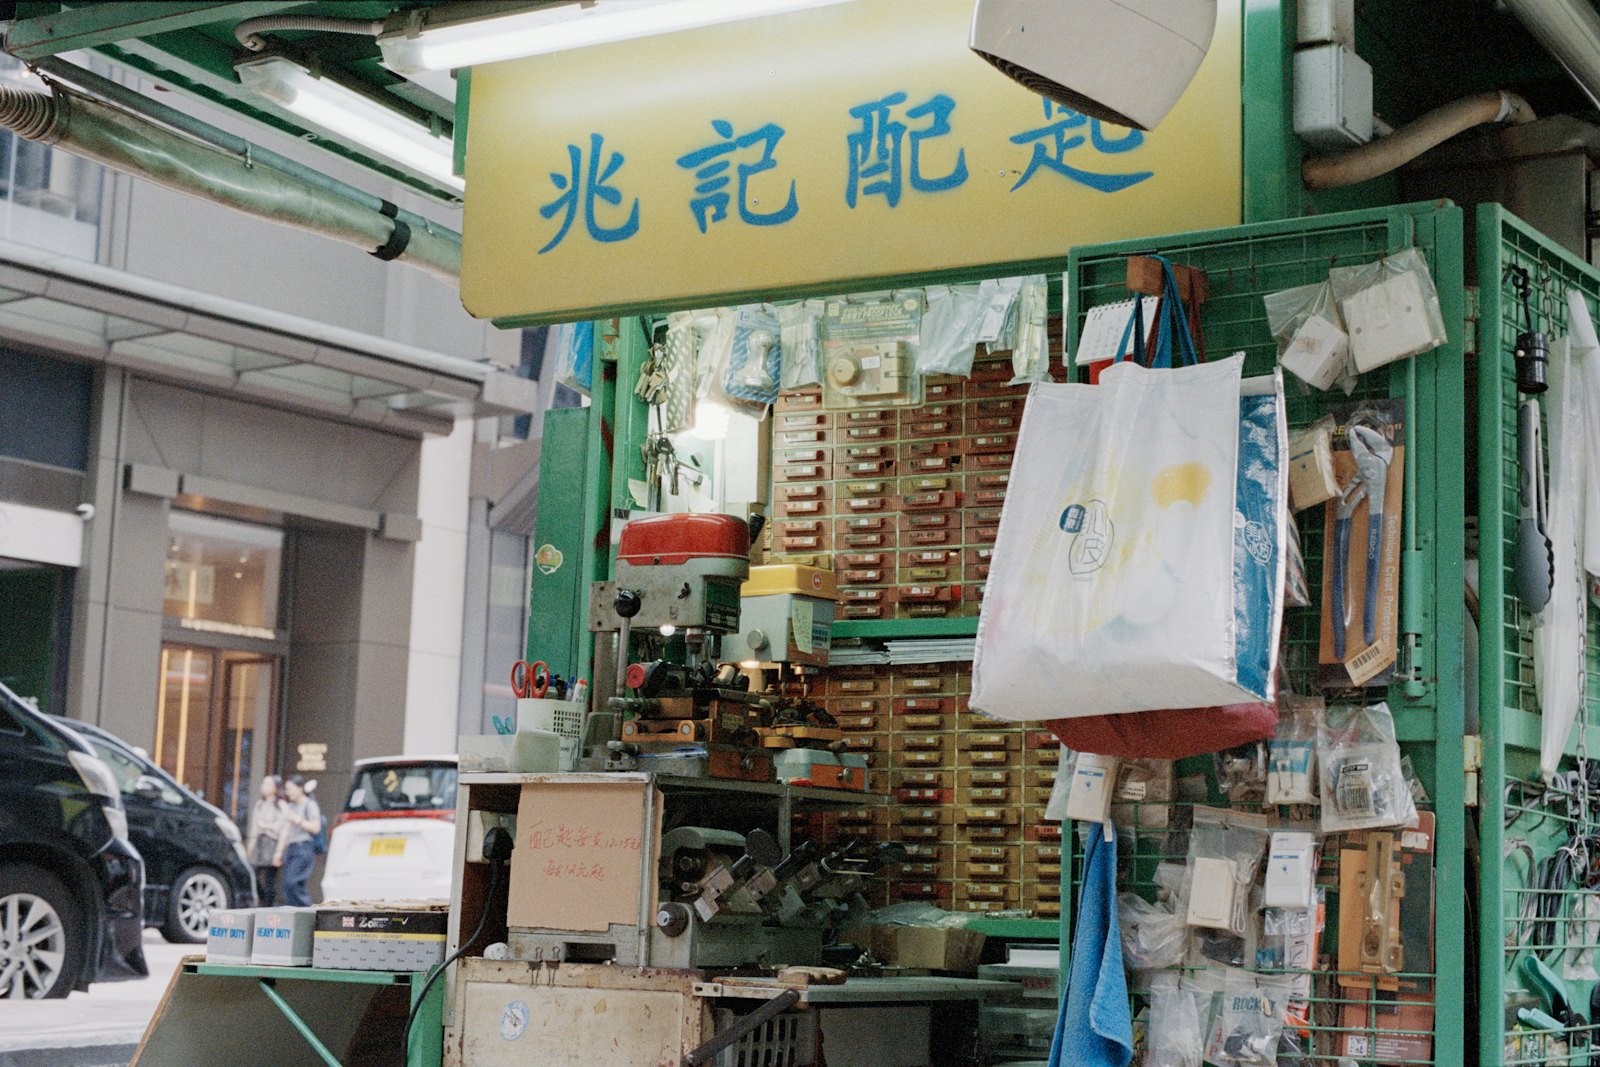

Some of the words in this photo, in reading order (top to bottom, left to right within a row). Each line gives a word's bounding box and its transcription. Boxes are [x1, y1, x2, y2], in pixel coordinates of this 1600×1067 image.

[538, 91, 1154, 254] 兆記配匙
[210, 926, 228, 937] HEAVY
[229, 928, 246, 939] DUTY
[256, 927, 275, 938] HEAVY
[275, 928, 292, 939] DUTY
[1232, 996, 1276, 1014] ROCKT
